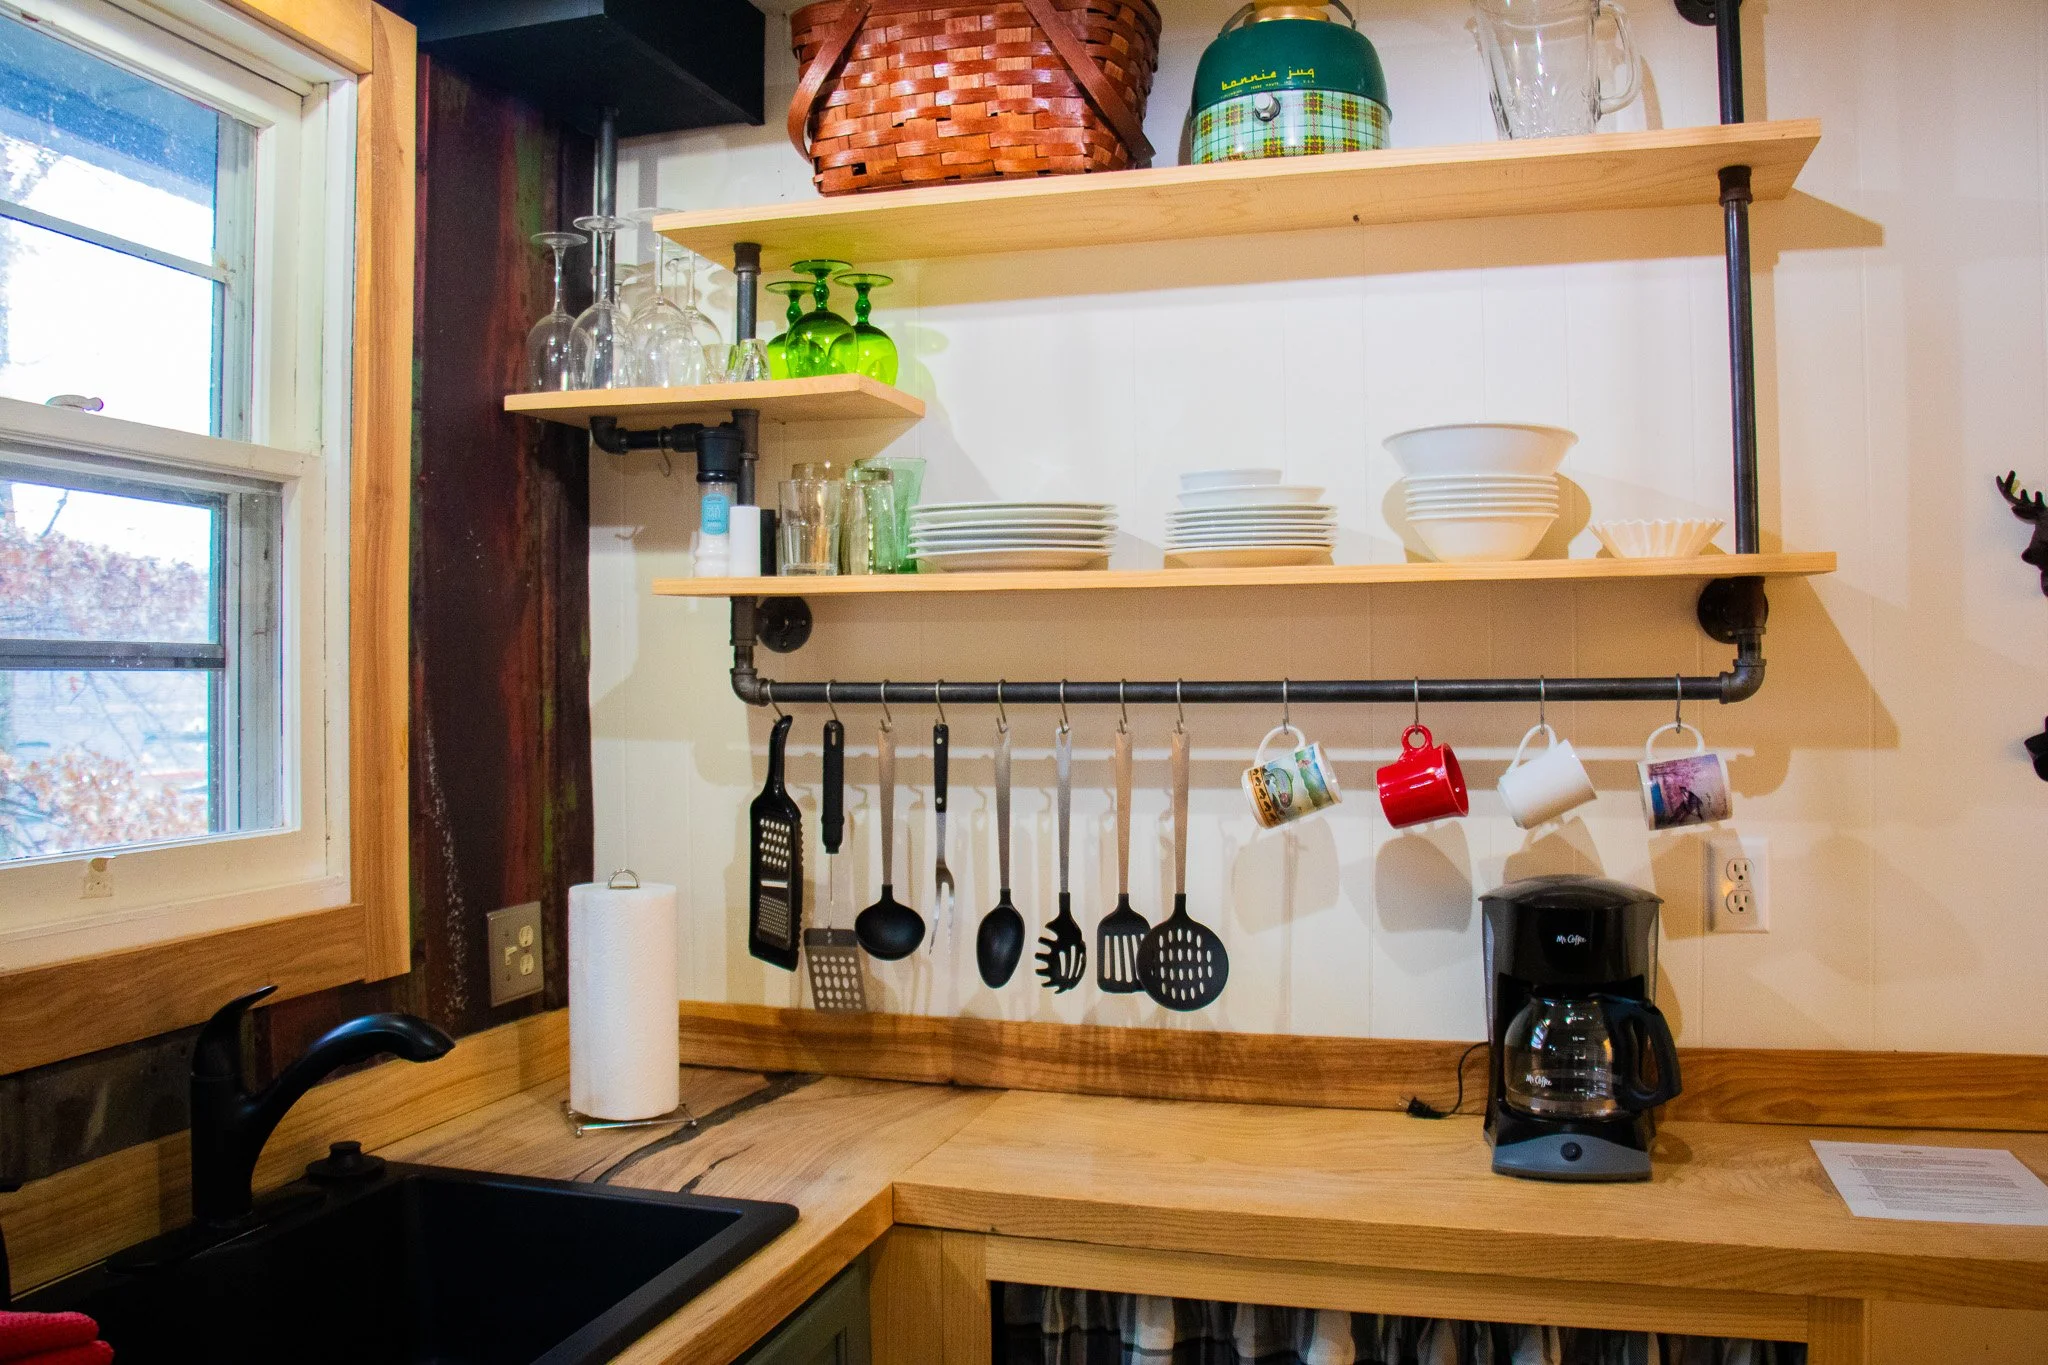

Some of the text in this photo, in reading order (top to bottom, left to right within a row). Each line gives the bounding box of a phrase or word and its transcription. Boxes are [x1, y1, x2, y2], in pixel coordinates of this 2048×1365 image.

[1221, 65, 1315, 91] bonnie jug
[1567, 934, 1587, 946] Coffee
[1534, 1075, 1553, 1088] Coffee
